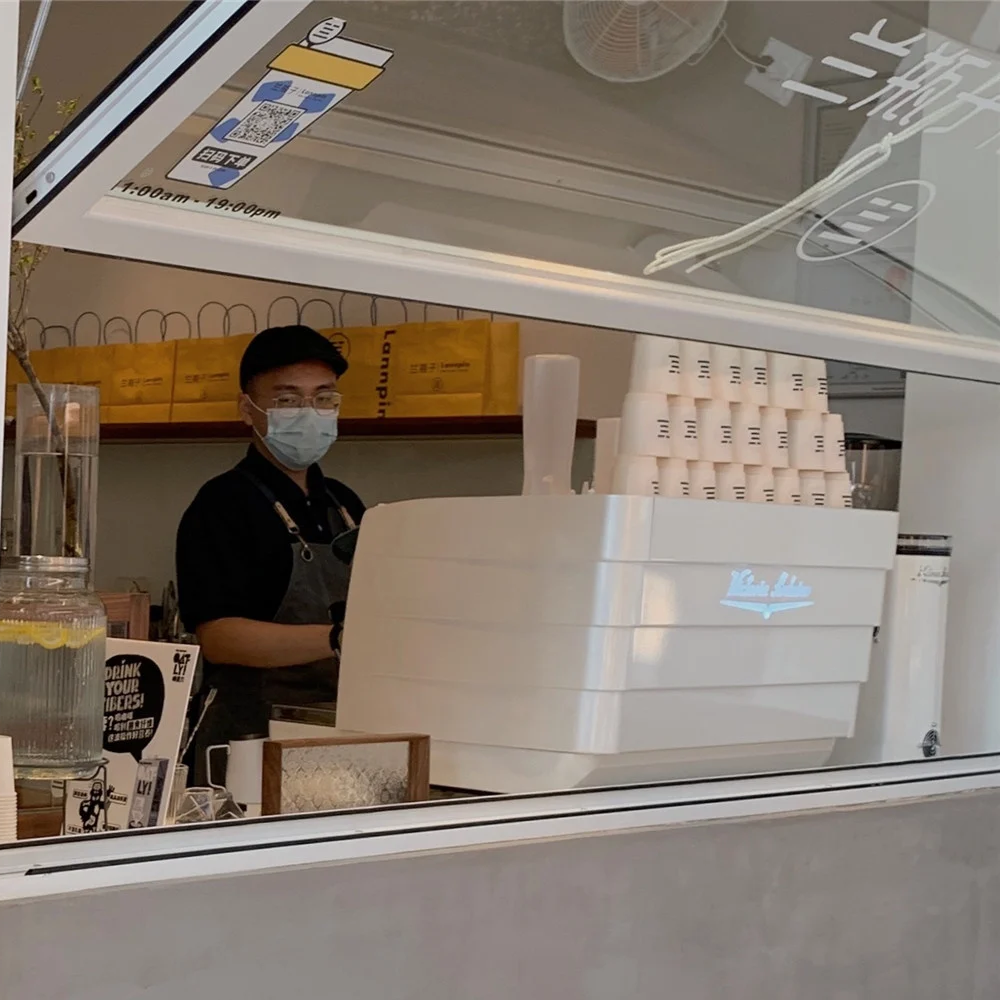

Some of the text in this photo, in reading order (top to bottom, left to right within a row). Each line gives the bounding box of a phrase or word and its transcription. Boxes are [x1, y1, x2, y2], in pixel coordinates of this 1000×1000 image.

[196, 148, 252, 168] 扫码下单
[205, 197, 282, 220] 19:00pm
[105, 678, 140, 697] YOUR
[104, 693, 145, 713] IBERS!
